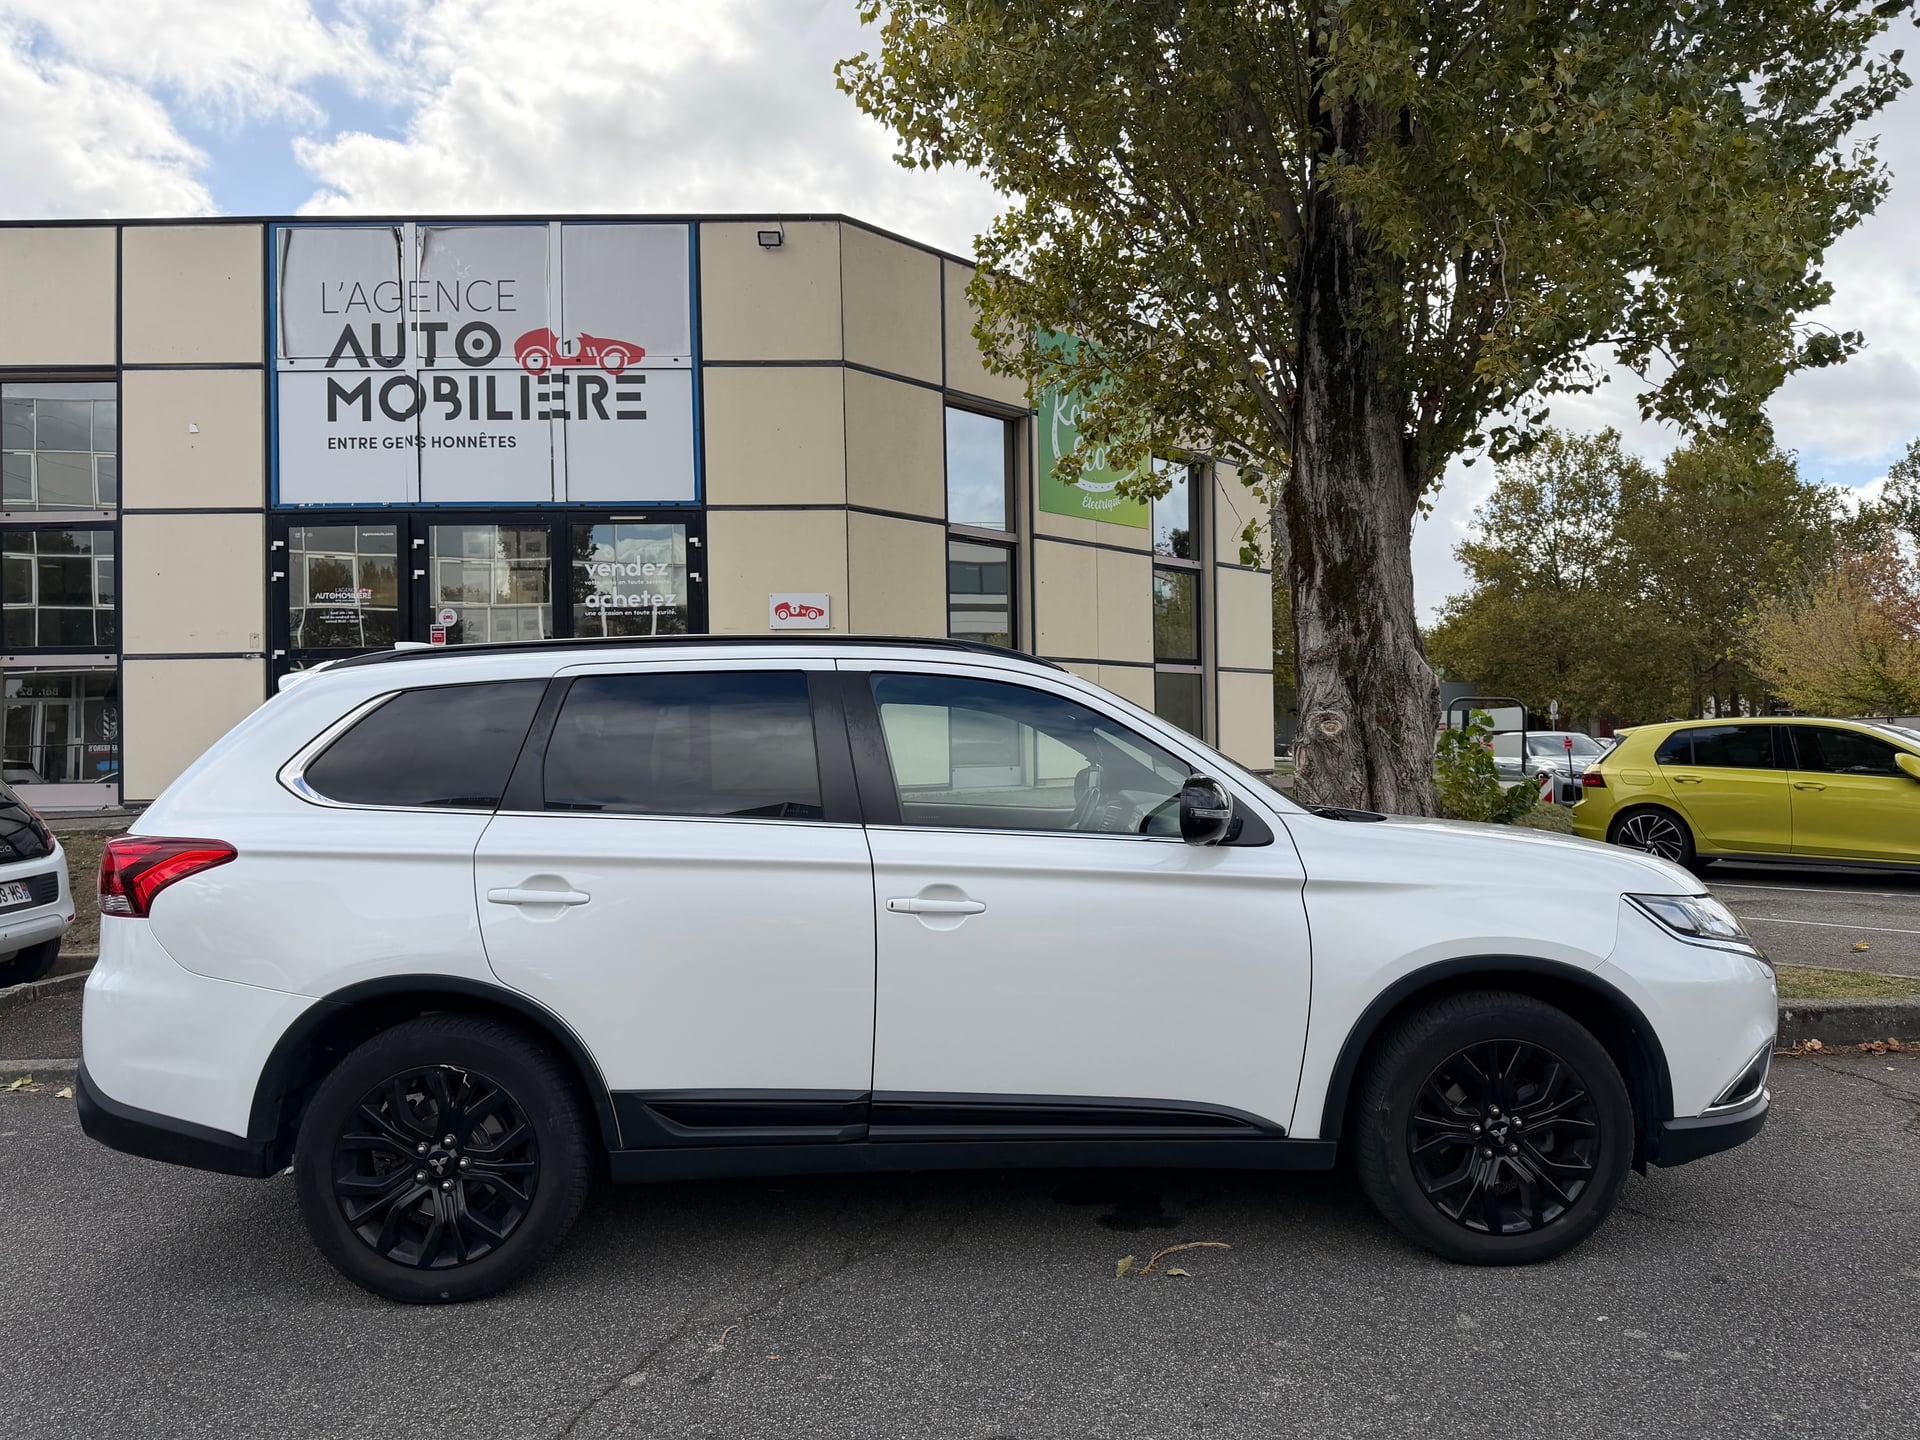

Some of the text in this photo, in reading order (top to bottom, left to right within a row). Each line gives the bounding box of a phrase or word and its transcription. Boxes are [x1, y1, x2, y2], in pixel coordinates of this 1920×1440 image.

[321, 279, 517, 314] L'AGENCE
[324, 320, 502, 369] AUTO
[563, 339, 572, 355] 1
[327, 373, 647, 422] MOBILIERE
[327, 431, 517, 450] ENTRE GENS HONNÊTES
[584, 554, 669, 577] vendez
[584, 586, 677, 609] achetez
[598, 609, 624, 617] ocasion
[633, 608, 650, 617] toute
[652, 607, 678, 617] curité.
